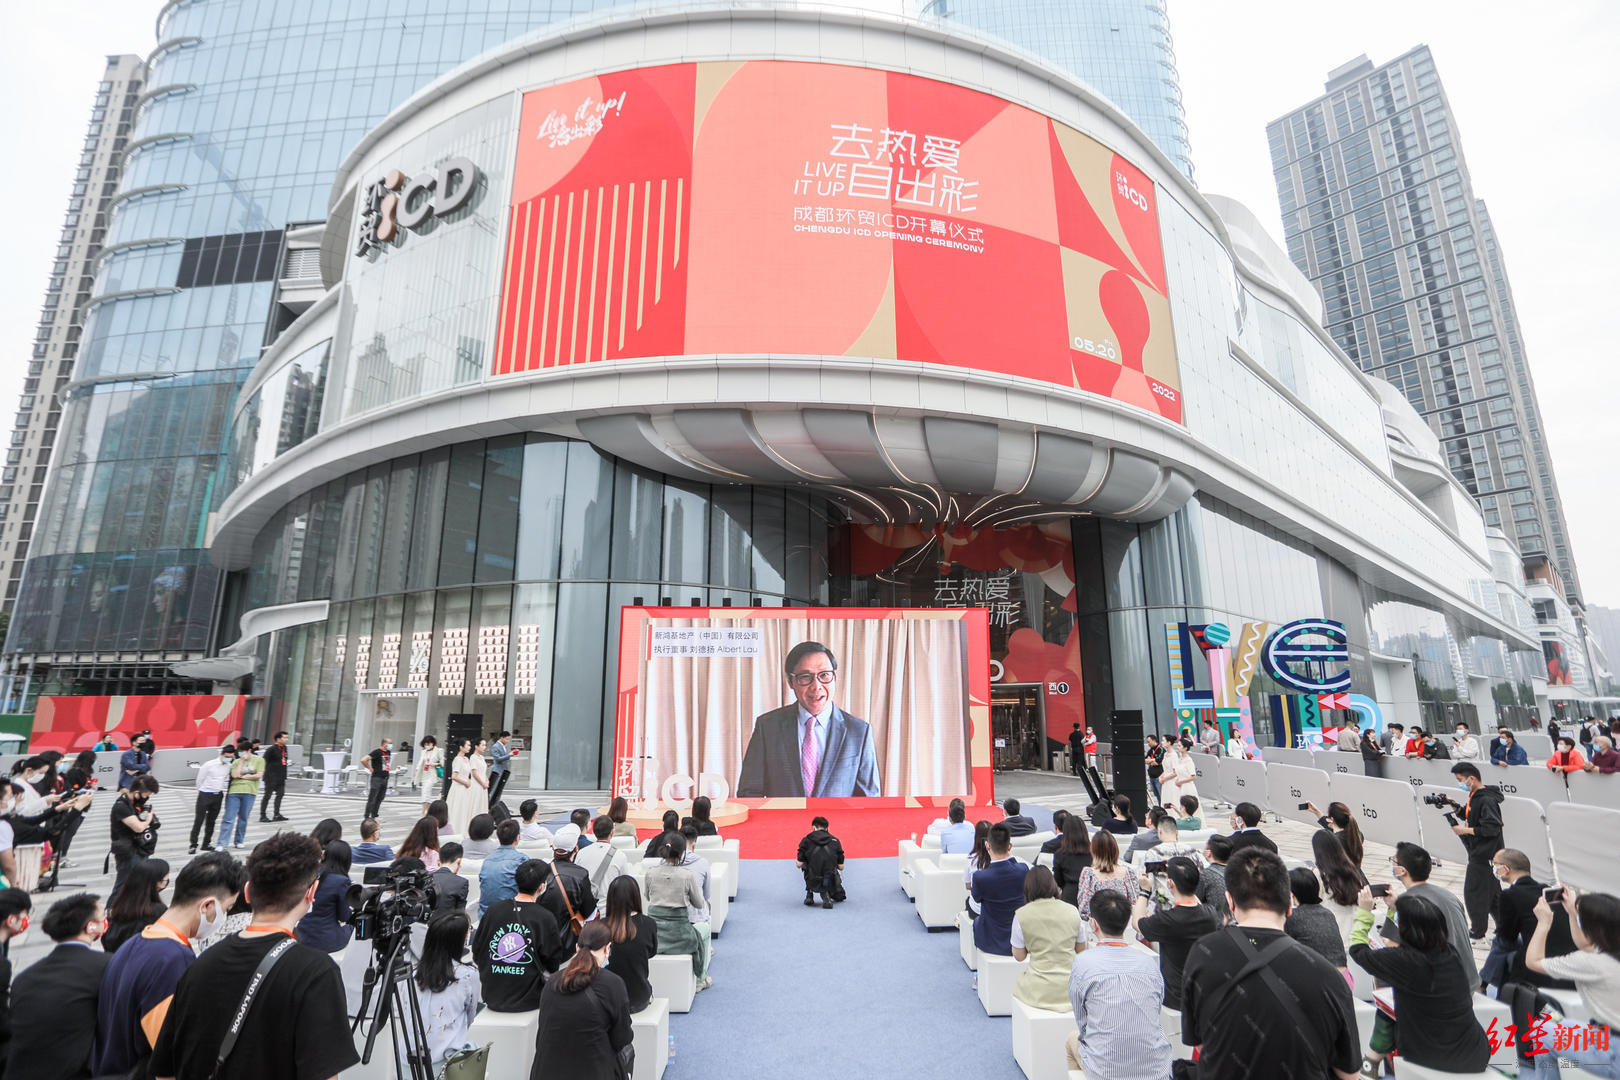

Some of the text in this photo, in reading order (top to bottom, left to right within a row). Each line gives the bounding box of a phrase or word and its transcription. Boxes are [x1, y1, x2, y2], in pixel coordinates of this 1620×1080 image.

[829, 123, 961, 173] 去热爱
[803, 161, 848, 179] LIVE
[793, 179, 846, 197] IT UP
[848, 161, 980, 214] 自出彩
[793, 205, 985, 244] 成都环贸ICD开幕仪式
[793, 224, 985, 254] CHENGDU ICD OPENING CEREMONY
[1074, 336, 1117, 360] 05.20
[1151, 382, 1177, 402] 2022
[934, 577, 1010, 601] 去热爱
[717, 645, 742, 653] Albert
[1362, 804, 1378, 819] iCD
[490, 927, 506, 949] NEW
[491, 964, 526, 976] YANKEES
[231, 973, 262, 1034] FIND KAPOOR
